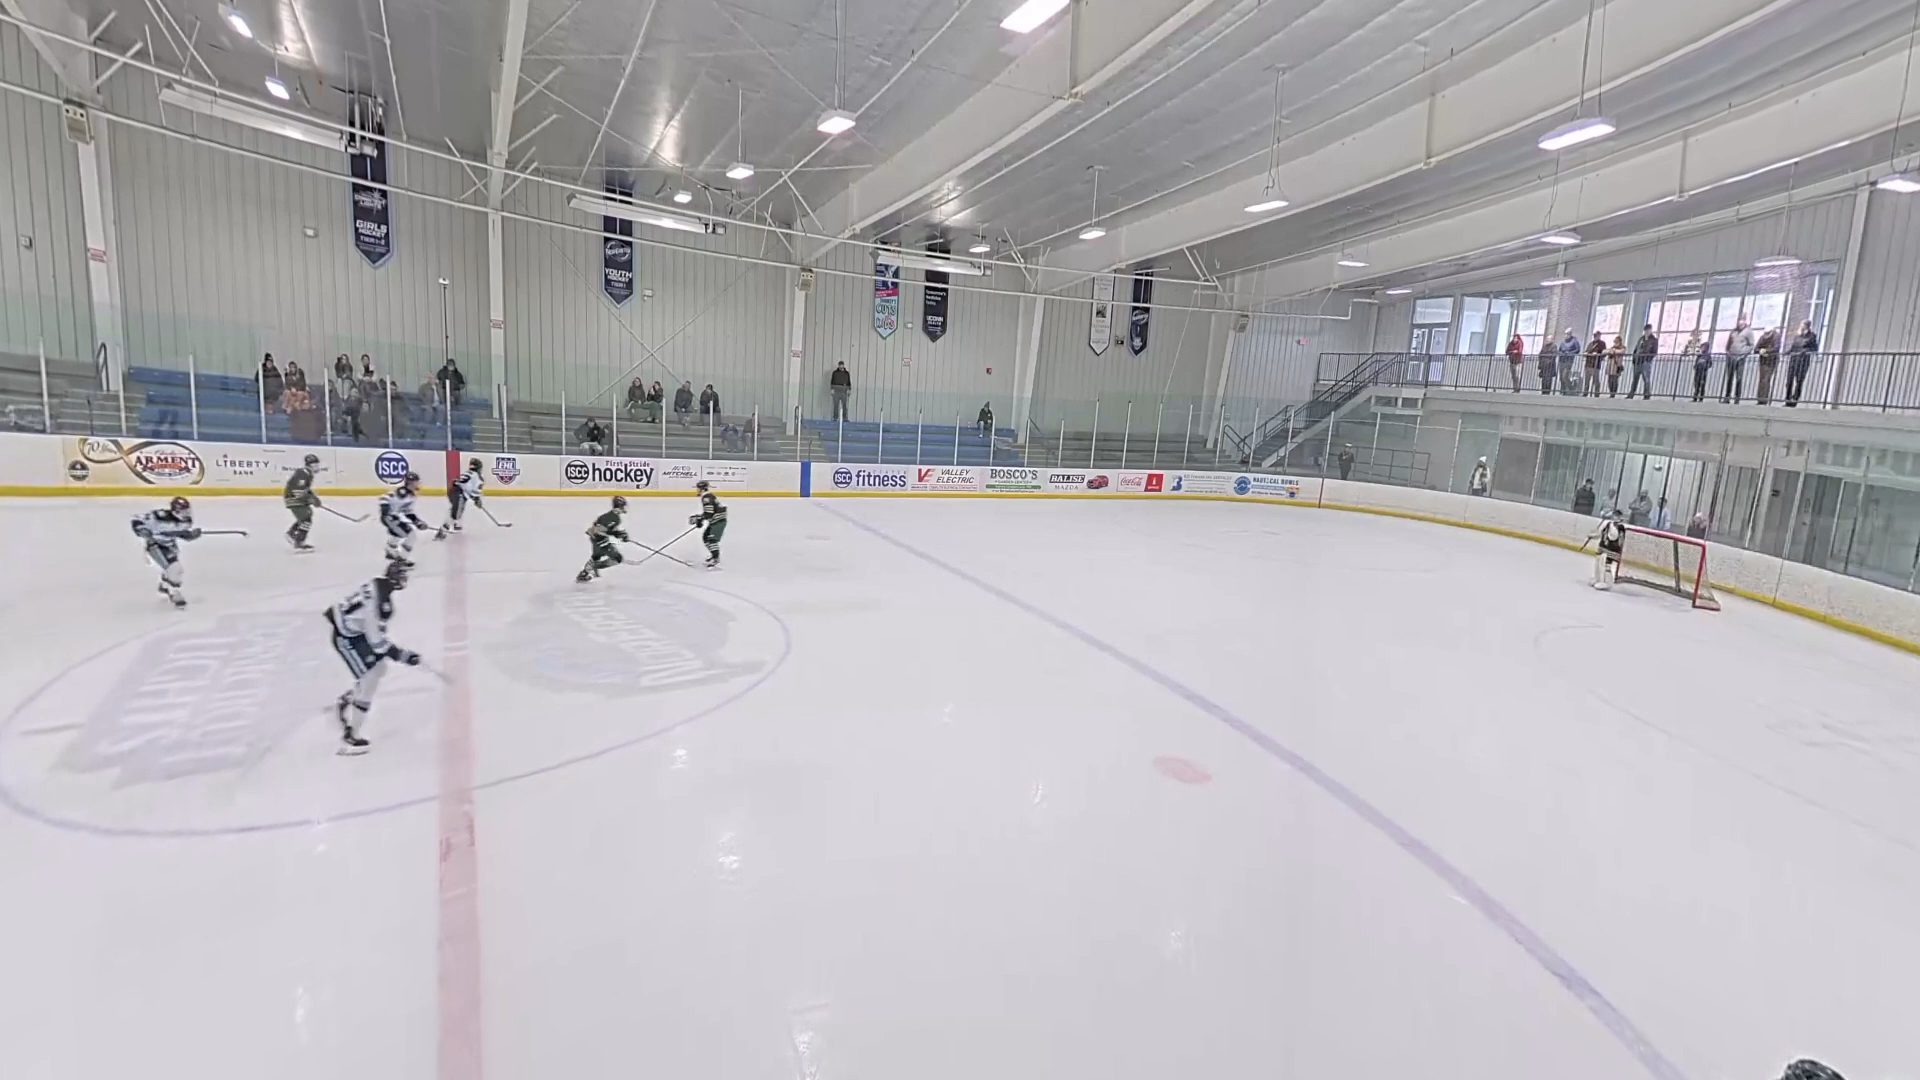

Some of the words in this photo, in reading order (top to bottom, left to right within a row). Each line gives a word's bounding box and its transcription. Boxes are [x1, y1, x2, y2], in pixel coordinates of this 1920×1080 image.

[356, 220, 387, 233] GIRLS
[359, 228, 385, 237] HOCKEY
[605, 267, 632, 278] YOUTH
[876, 304, 896, 316] CUTS
[133, 455, 200, 468] ARMENT
[215, 458, 270, 468] LIBERTY
[378, 461, 407, 475] ISCC
[567, 466, 588, 478] ISCC
[990, 469, 1038, 479] BOSCO'S
[591, 463, 655, 488] hockey
[834, 473, 851, 483] ISCC
[855, 470, 907, 487] fitness
